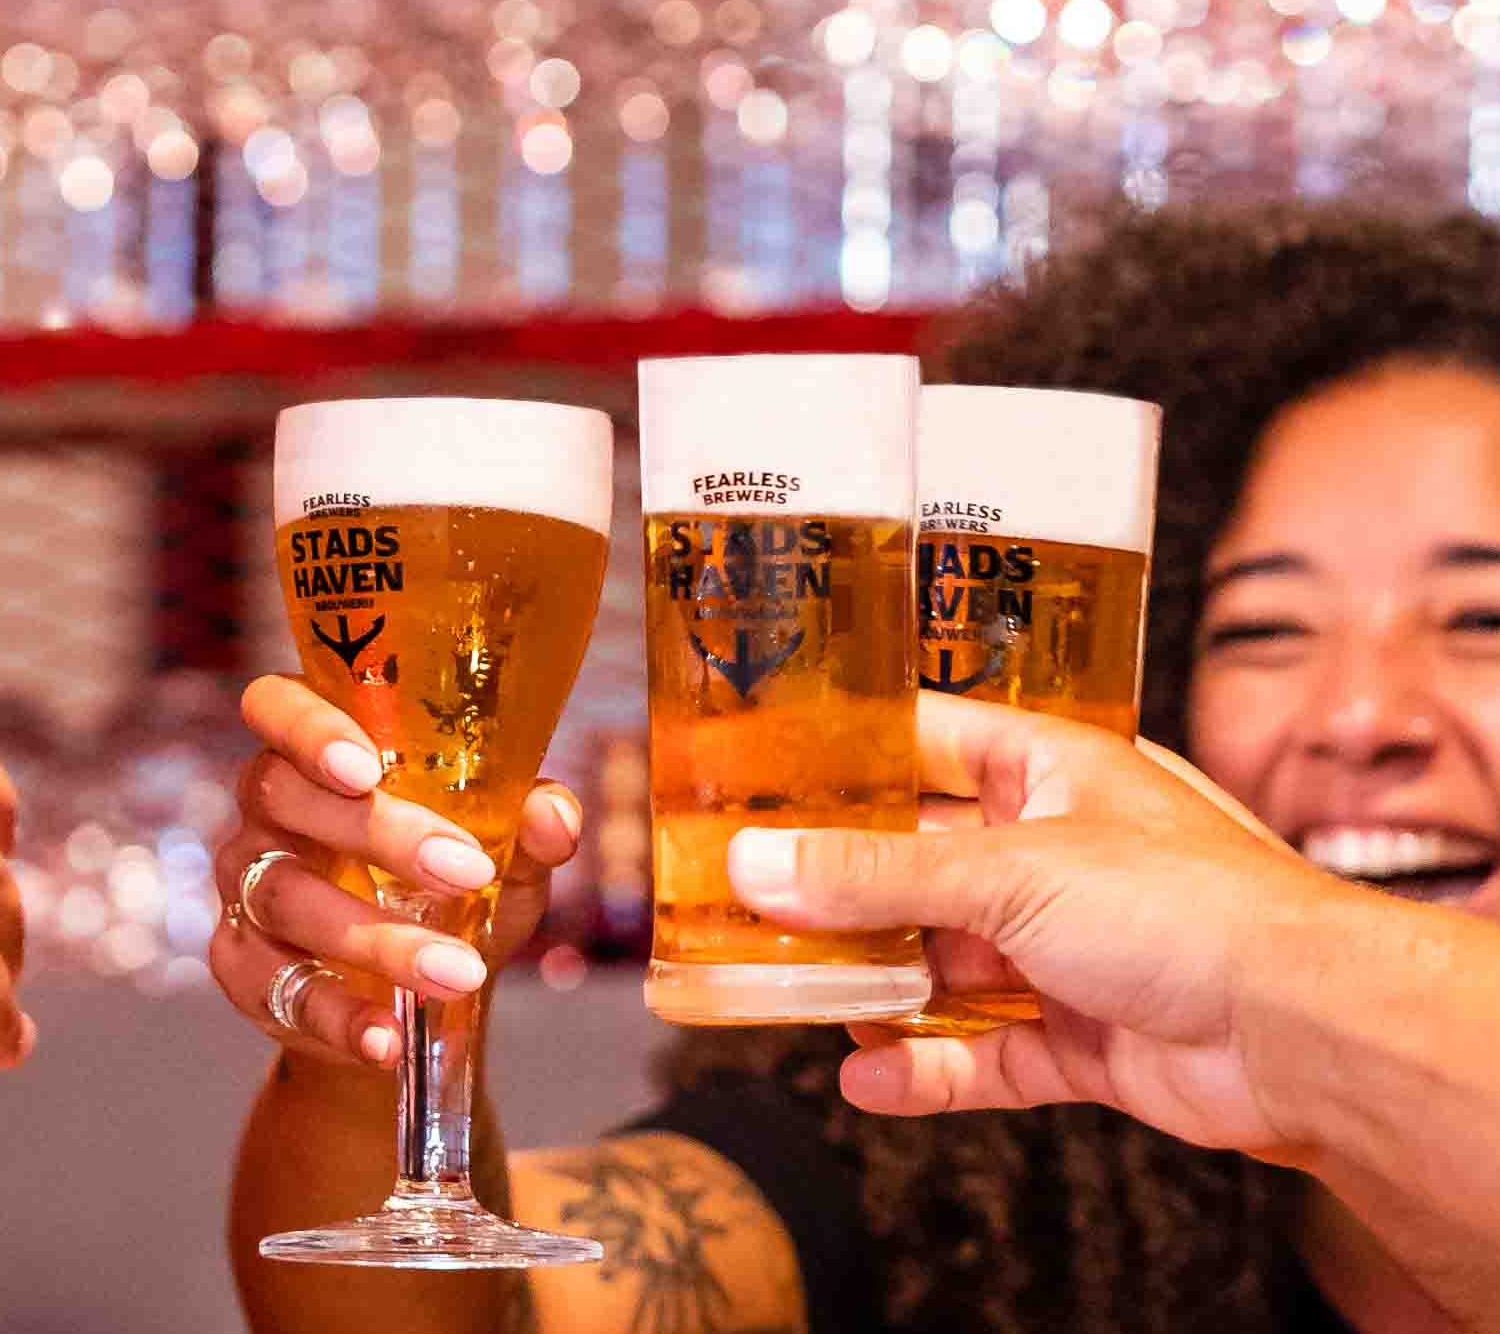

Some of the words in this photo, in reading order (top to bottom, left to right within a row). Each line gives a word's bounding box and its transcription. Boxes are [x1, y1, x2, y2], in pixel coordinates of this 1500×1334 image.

[693, 472, 801, 493] FEARLESS
[303, 492, 371, 512] FEARLESS
[702, 490, 787, 505] BREWERS
[921, 501, 1003, 522] EARLESS
[291, 525, 400, 563] STADS
[670, 522, 832, 556] STADS
[294, 562, 404, 598] HAVEN
[670, 563, 832, 600] HAVEN
